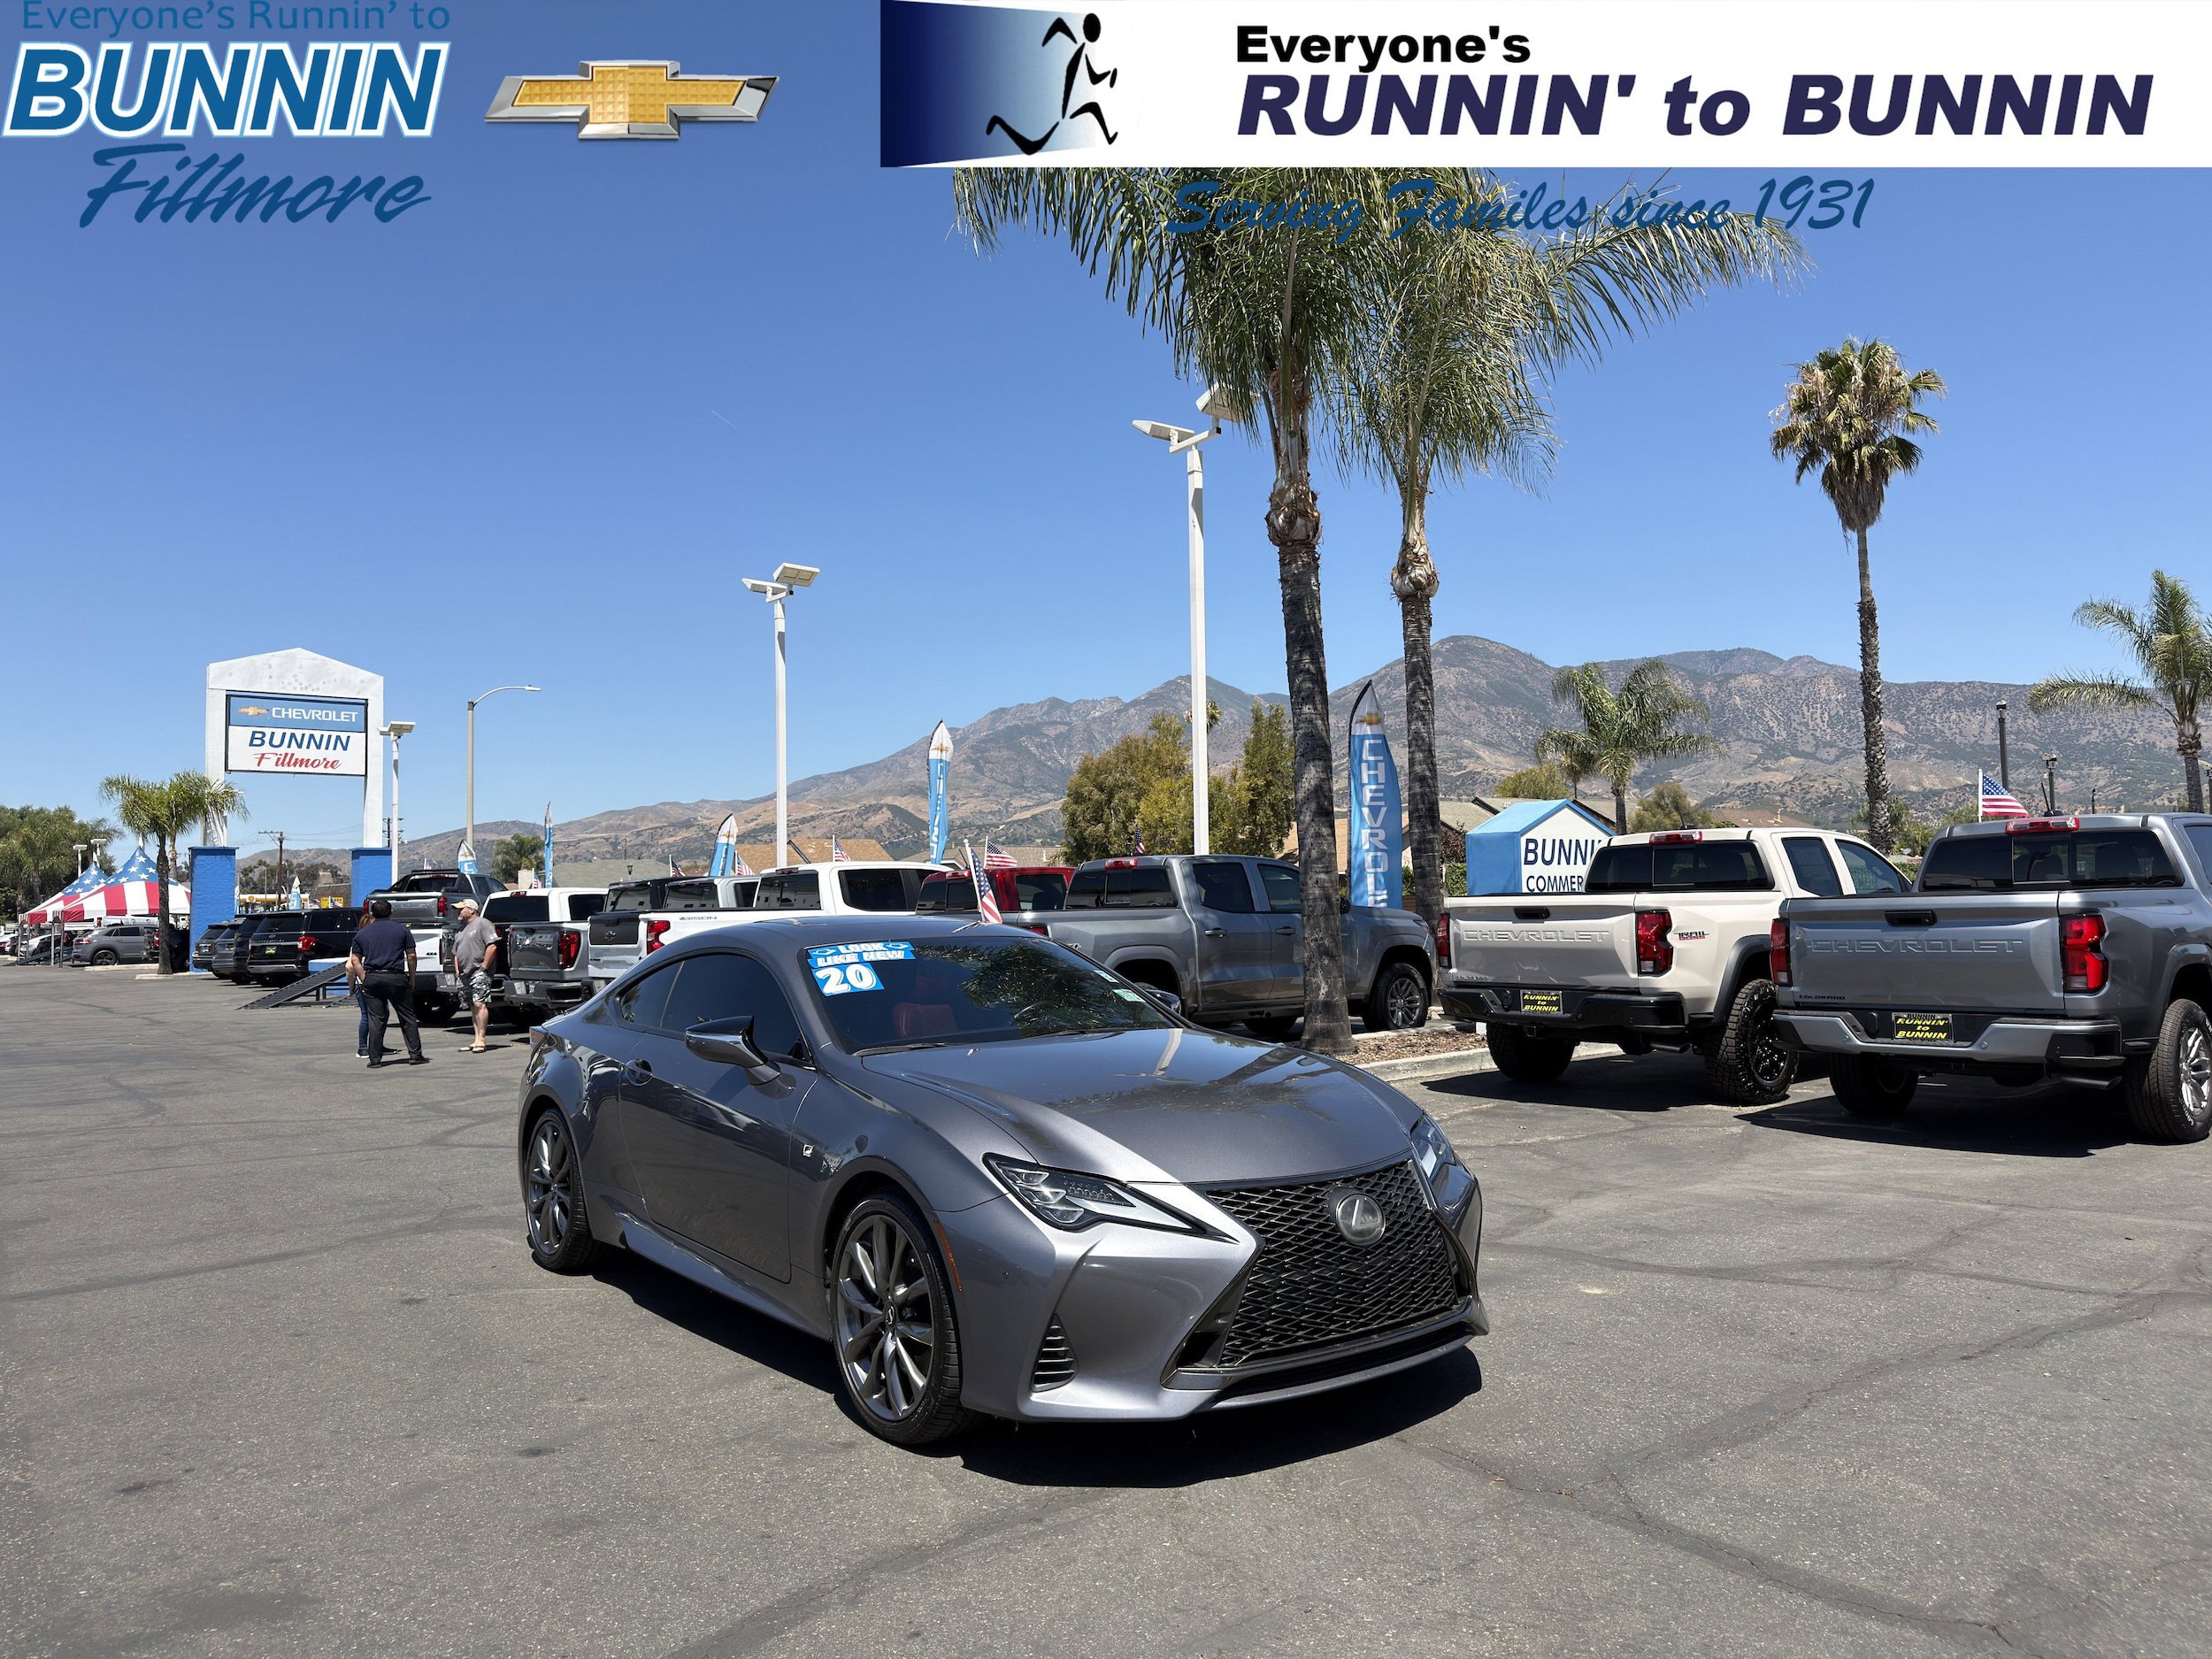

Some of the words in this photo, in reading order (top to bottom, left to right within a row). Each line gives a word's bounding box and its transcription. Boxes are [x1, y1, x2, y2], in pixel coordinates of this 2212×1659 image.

[272, 707, 358, 723] CHEVROLET
[249, 730, 351, 751] BUNNIN
[253, 752, 342, 770] Fillmore
[1524, 838, 1601, 866] BUNNI
[1463, 930, 1609, 942] CHEVROLET
[837, 942, 887, 954] LOOK
[1810, 939, 2024, 953] CHEVROLET
[862, 950, 905, 962] NEW
[815, 964, 877, 996] 20
